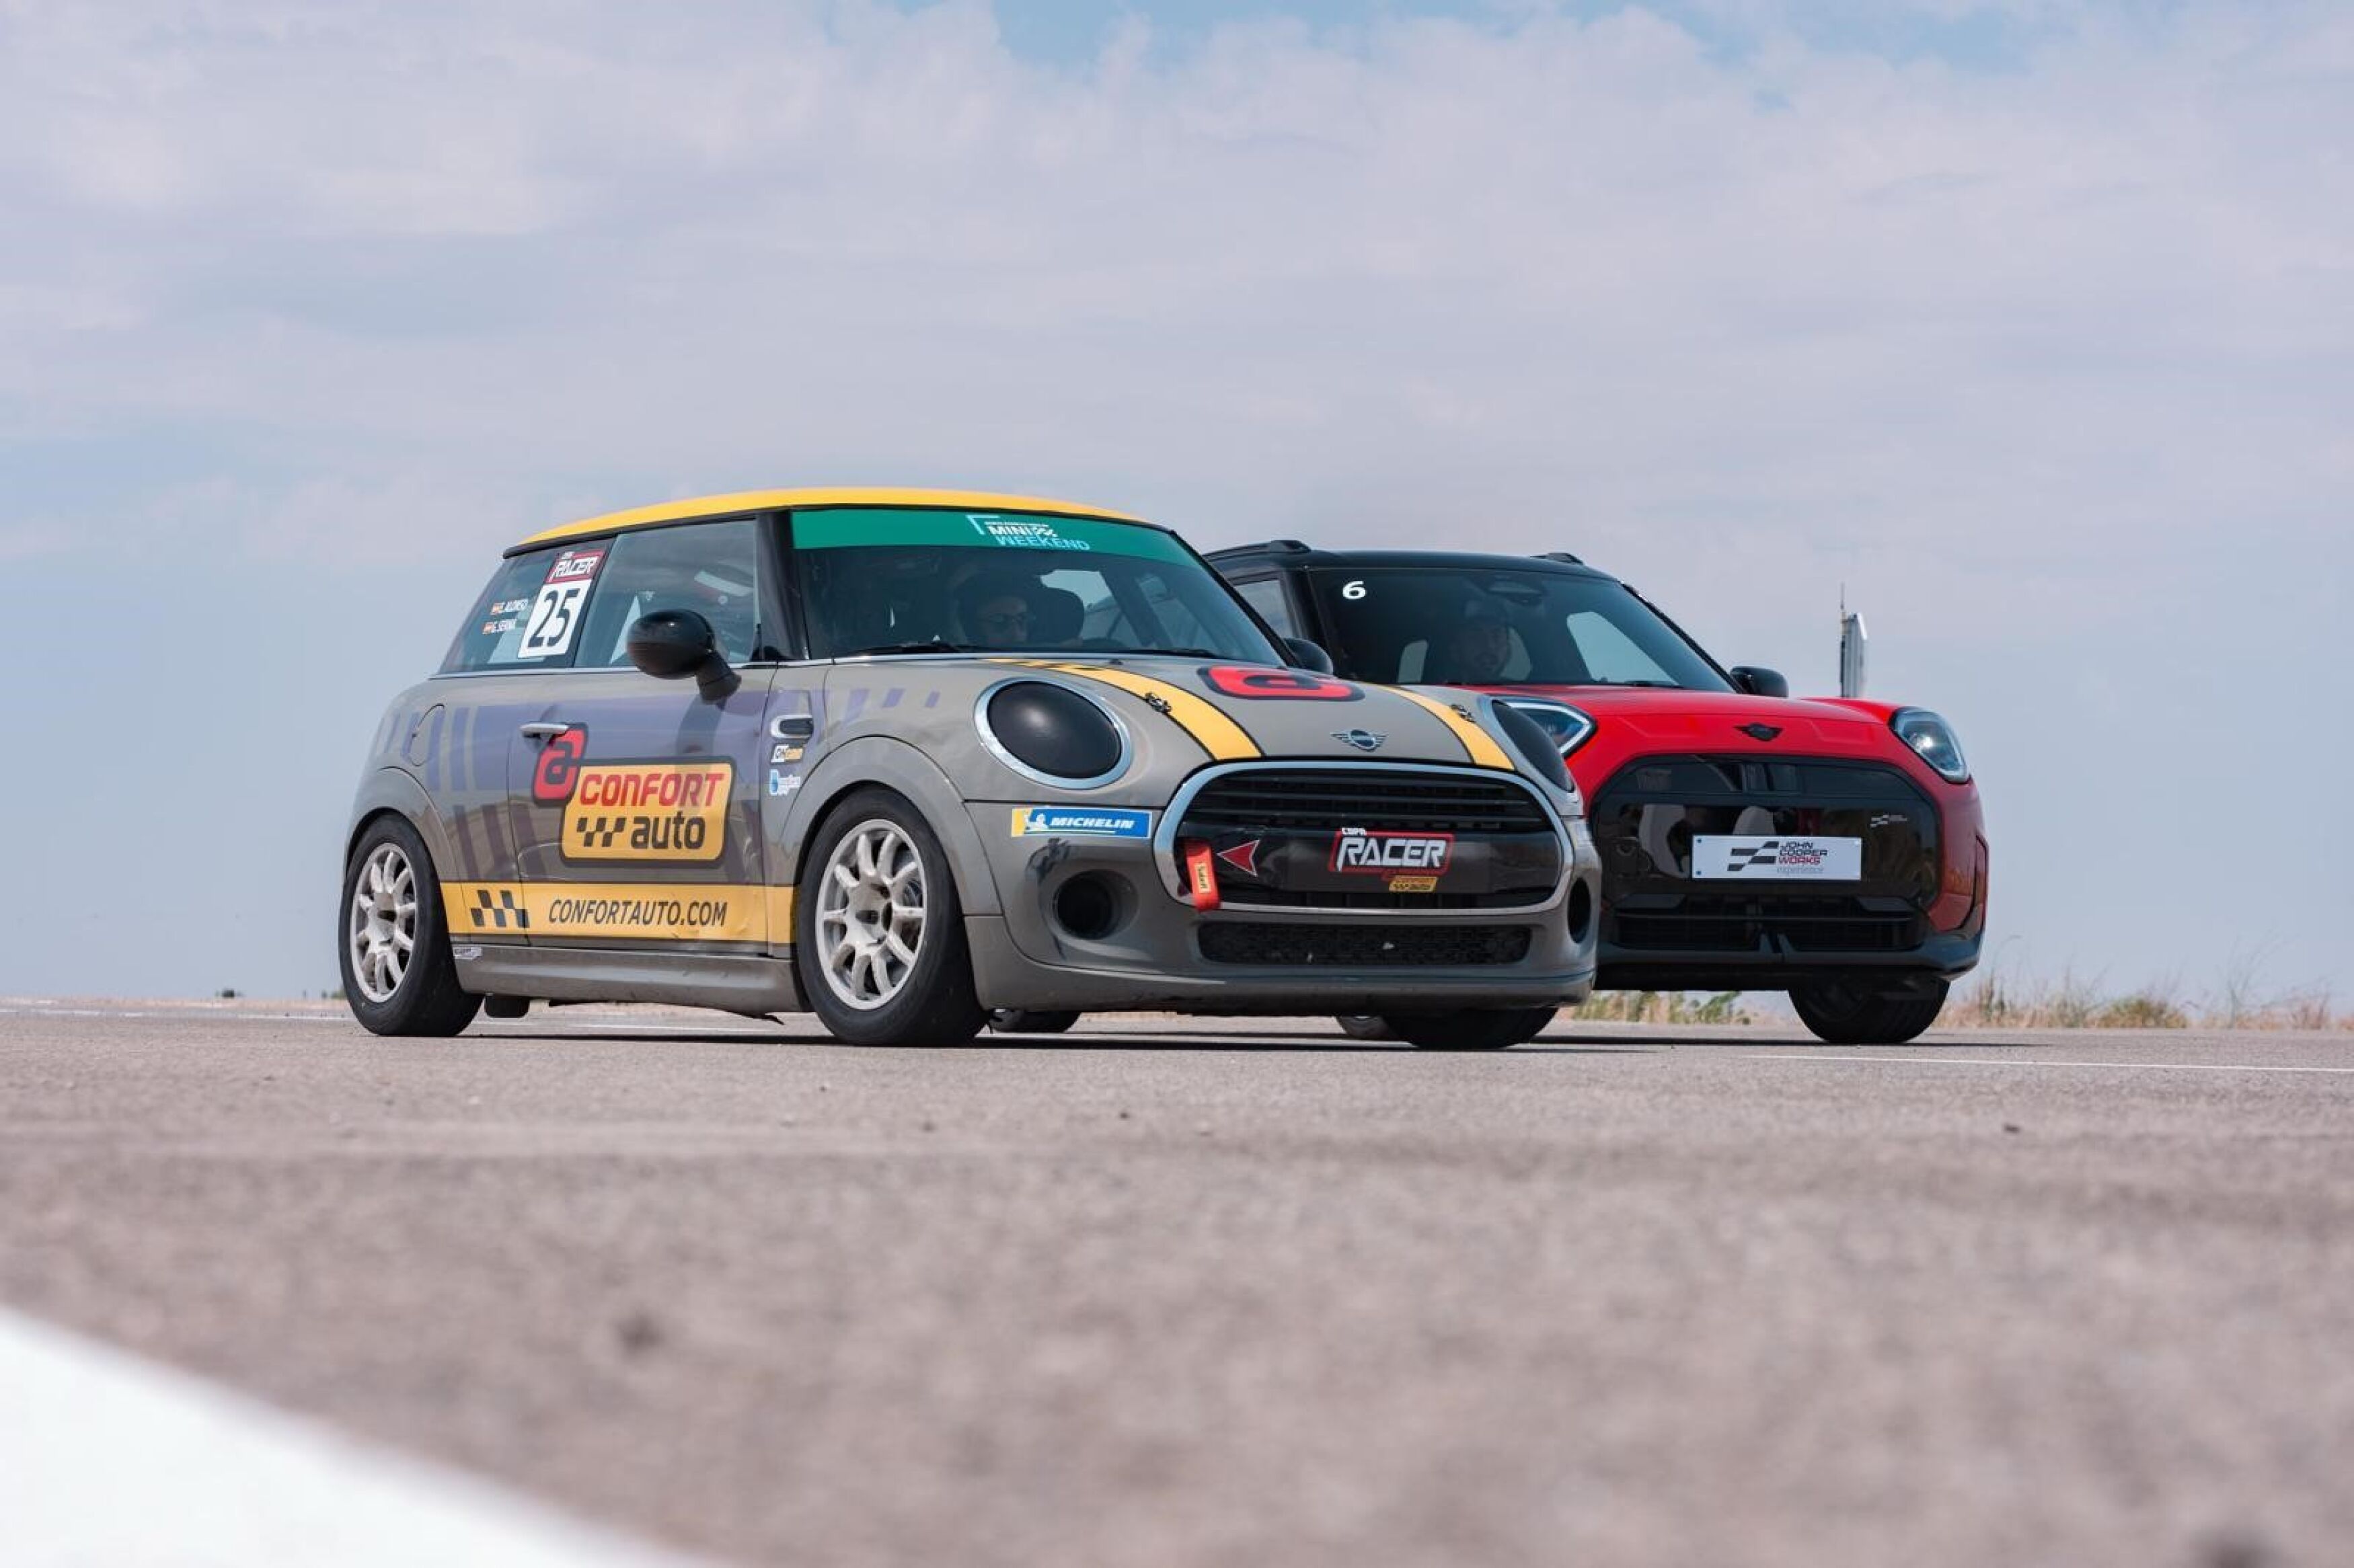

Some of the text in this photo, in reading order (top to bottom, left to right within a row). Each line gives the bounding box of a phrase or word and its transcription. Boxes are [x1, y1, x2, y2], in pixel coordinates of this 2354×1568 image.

[995, 535, 1091, 550] WEEKEND
[548, 557, 598, 583] RACER
[1342, 581, 1366, 599] 6
[527, 588, 580, 648] 25
[580, 773, 724, 807] CONFORT
[631, 811, 706, 849] auto
[1051, 817, 1135, 828] MICHELIN
[1336, 837, 1447, 871] RACER
[1780, 841, 1813, 850] JOHN
[1778, 856, 1821, 865] WORKS
[548, 899, 728, 927] CONFORTAUTO.COM
